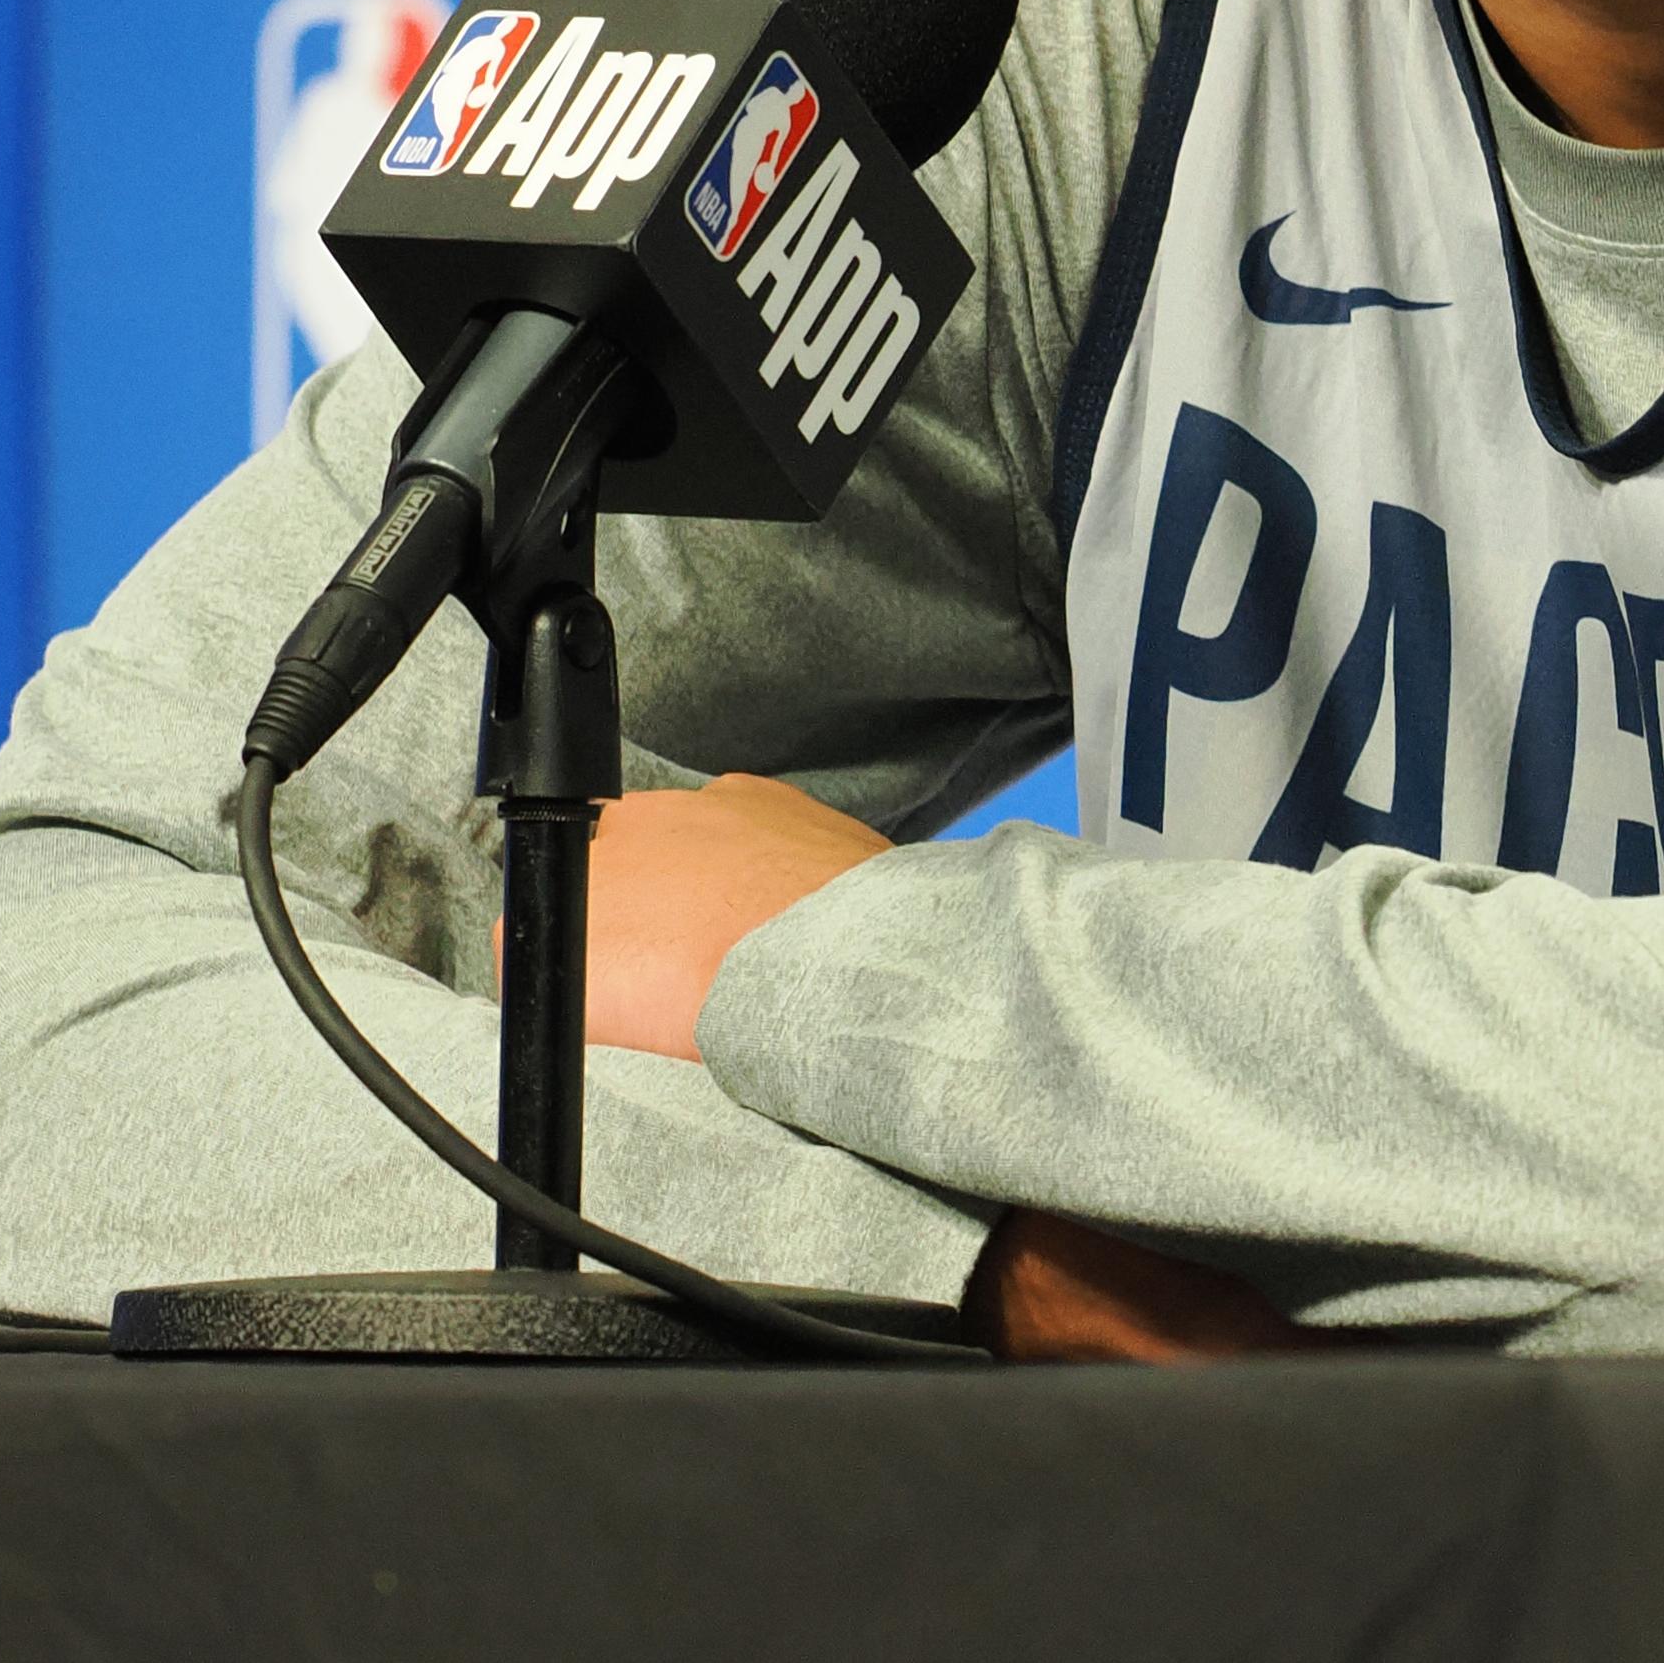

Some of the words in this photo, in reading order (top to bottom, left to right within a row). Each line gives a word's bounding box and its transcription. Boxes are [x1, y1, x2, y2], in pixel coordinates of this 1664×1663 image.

[392, 135, 438, 164] NBA
[463, 16, 716, 211] App
[693, 180, 729, 233] NBA
[737, 138, 921, 444] App
